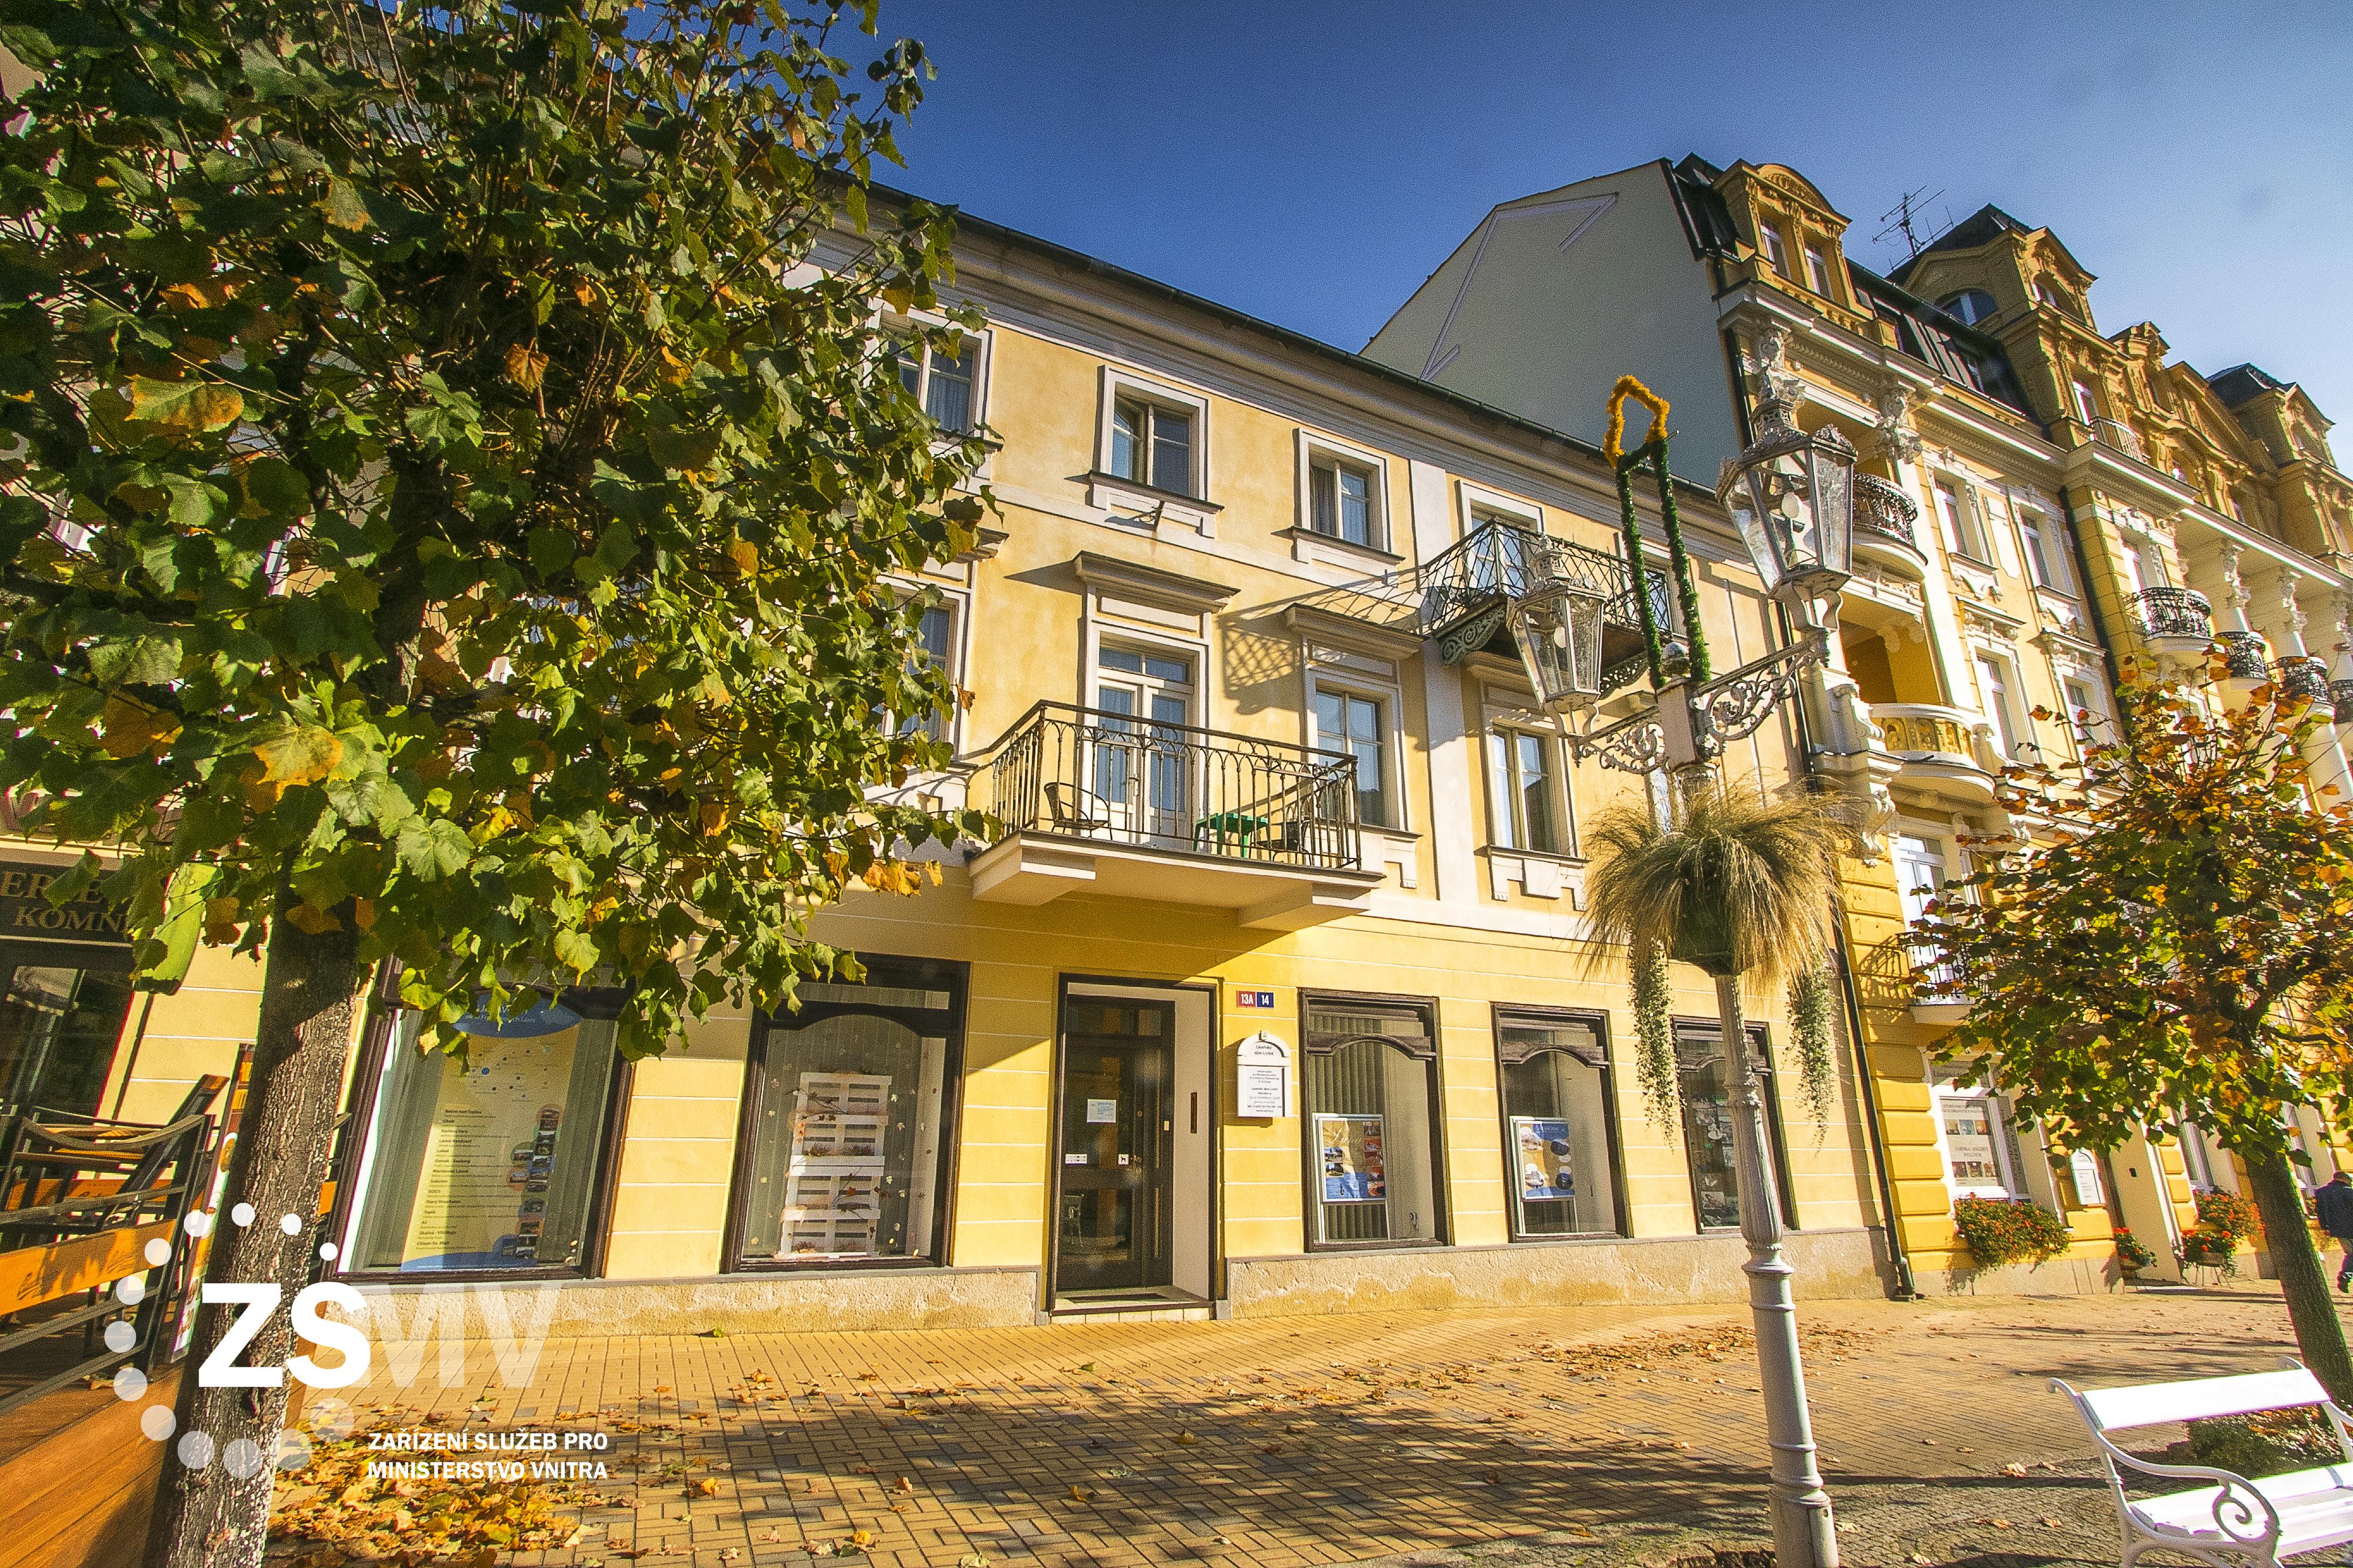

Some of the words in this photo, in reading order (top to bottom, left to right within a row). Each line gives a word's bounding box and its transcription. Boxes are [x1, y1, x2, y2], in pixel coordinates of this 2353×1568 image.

[0, 870, 106, 904] ERE
[12, 906, 128, 933] KOMN
[1241, 993, 1254, 1005] 13A
[1261, 995, 1269, 1005] 14
